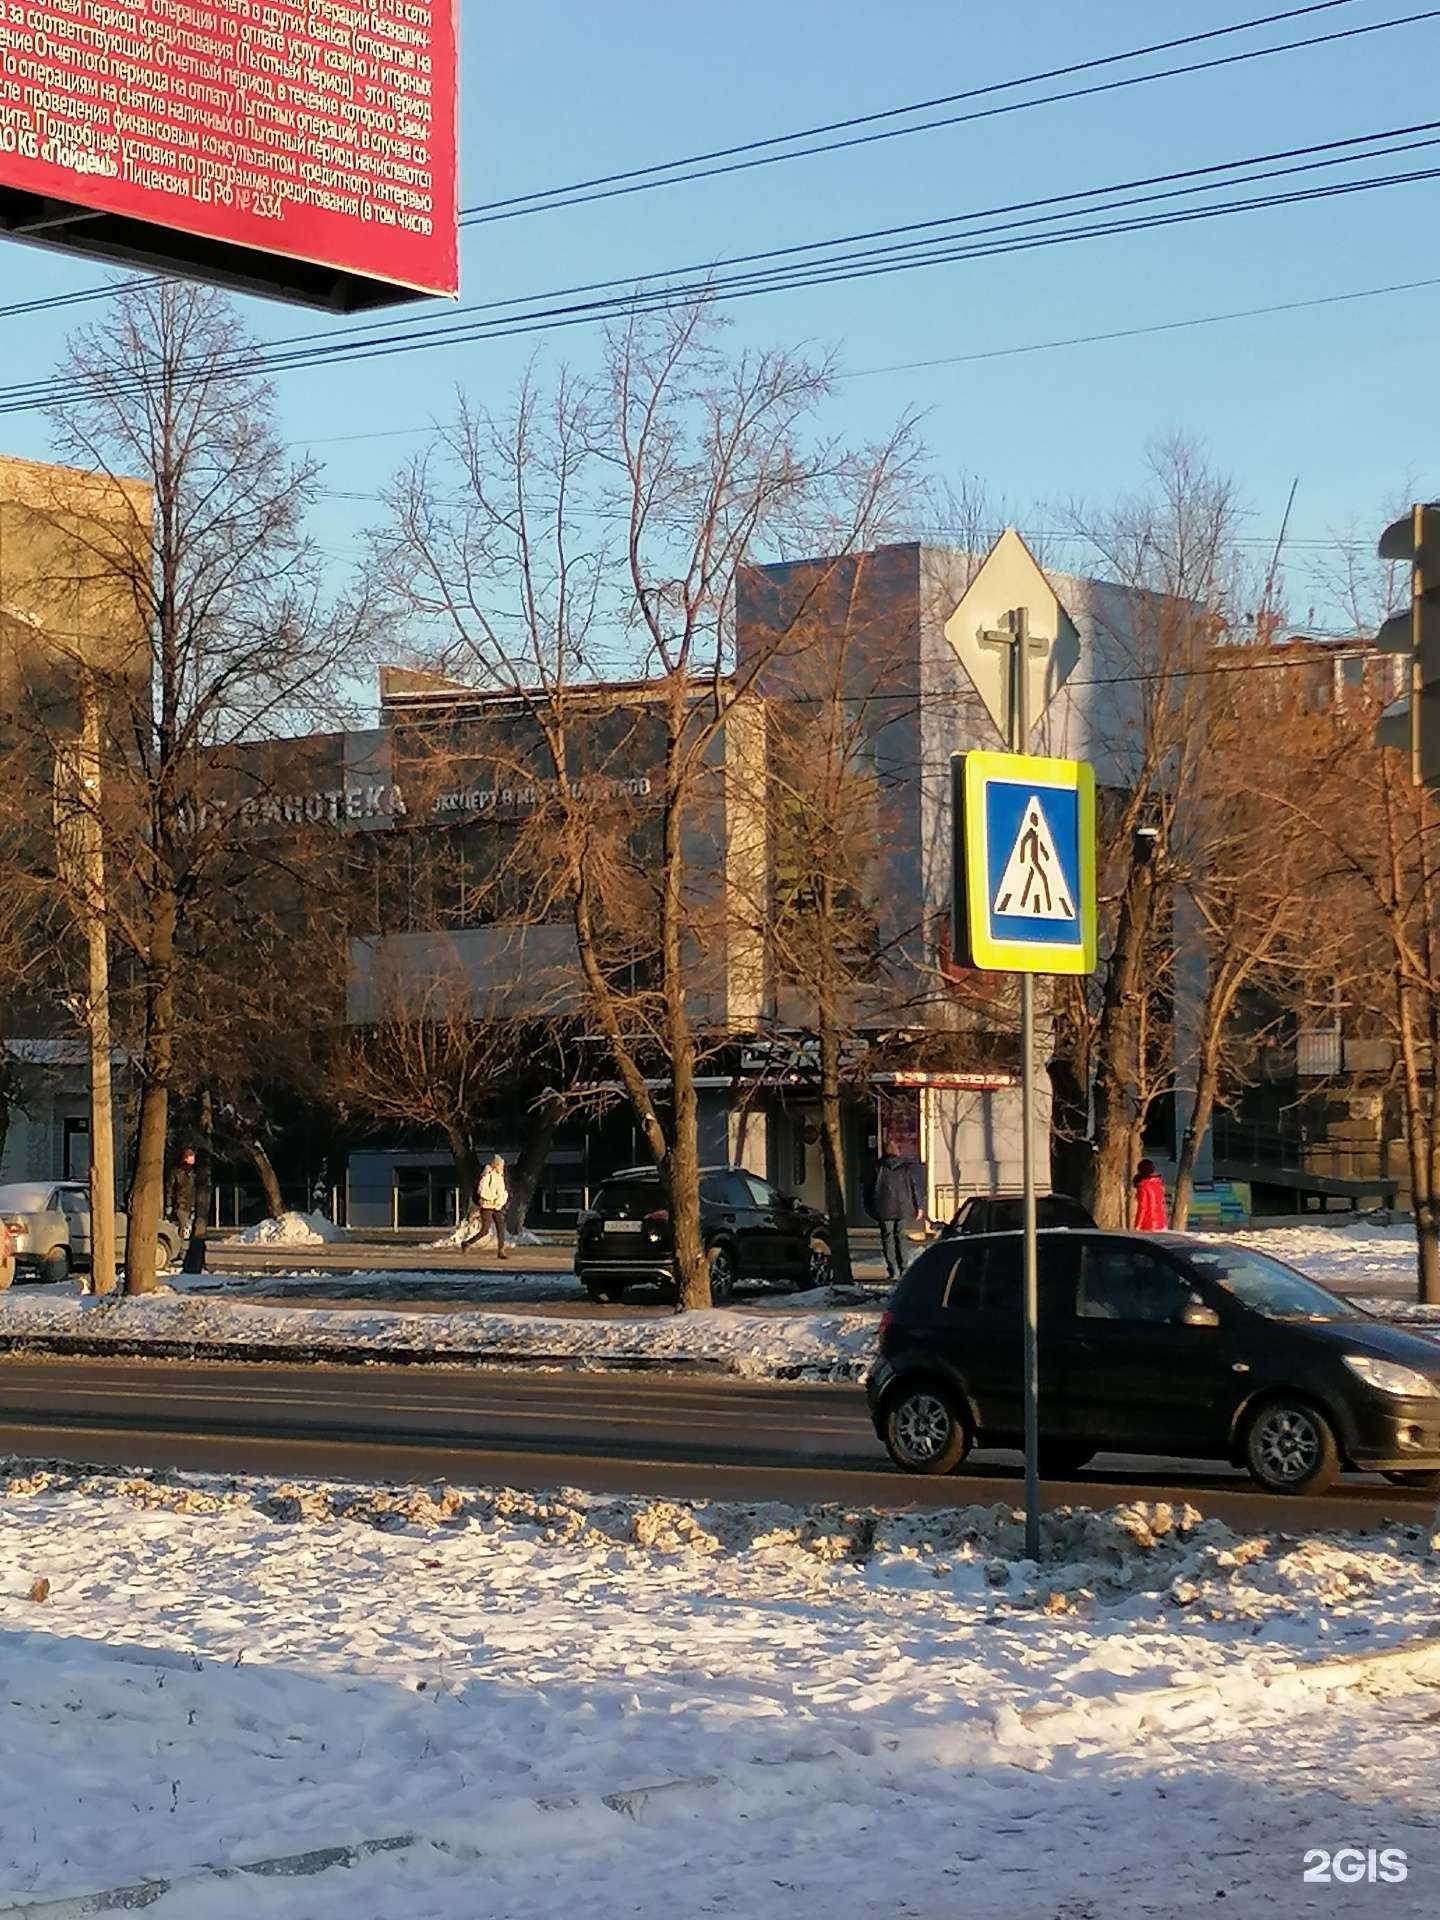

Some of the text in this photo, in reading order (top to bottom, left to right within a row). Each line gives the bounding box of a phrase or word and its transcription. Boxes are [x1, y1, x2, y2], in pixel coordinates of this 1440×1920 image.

[8, 4, 24, 25] за
[27, 10, 152, 61] соответствующий
[154, 39, 220, 81] Отчетный
[277, 82, 285, 100] в
[287, 84, 338, 115] течение
[341, 100, 394, 133] которого
[85, 1, 136, 34] период
[139, 16, 233, 60] кредитования
[364, 83, 384, 105] это
[387, 90, 431, 122] период
[152, 0, 216, 31] операции
[221, 17, 237, 37] по
[241, 22, 284, 51] оплате
[287, 36, 319, 68] услуг
[324, 47, 366, 76] казино
[369, 61, 377, 79] и
[252, 2, 259, 20] в
[263, 5, 305, 35] других
[307, 12, 350, 48] банках
[417, 53, 431, 73] на
[404, 3, 431, 26] сети
[20, 59, 97, 96] операциям
[101, 82, 117, 102] на
[119, 87, 164, 115] снятие
[167, 100, 232, 134] наличных
[235, 118, 242, 136] в
[244, 114, 306, 154] Льготный
[307, 139, 353, 170] период
[24, 86, 109, 125] проведения
[113, 103, 199, 149] финансовым
[201, 133, 295, 175] консультантом
[299, 160, 370, 195] кредитного
[373, 180, 431, 213] интервью
[34, 30, 108, 74] Отчетного
[110, 59, 168, 92] периода
[171, 76, 186, 96] на
[188, 81, 233, 117] оплату
[236, 87, 295, 127] Льготных
[361, 130, 369, 148] в
[370, 132, 411, 161] случае
[412, 144, 431, 164] со-
[18, 130, 38, 158] КБ
[122, 156, 188, 196] Лицензия
[191, 174, 210, 203] ЦБ
[214, 179, 232, 209] РФ
[35, 108, 118, 153] Подробные
[121, 138, 176, 168] условия
[178, 153, 194, 173] по
[271, 177, 358, 216] кредитования
[374, 204, 395, 226] том
[396, 210, 431, 235] числе
